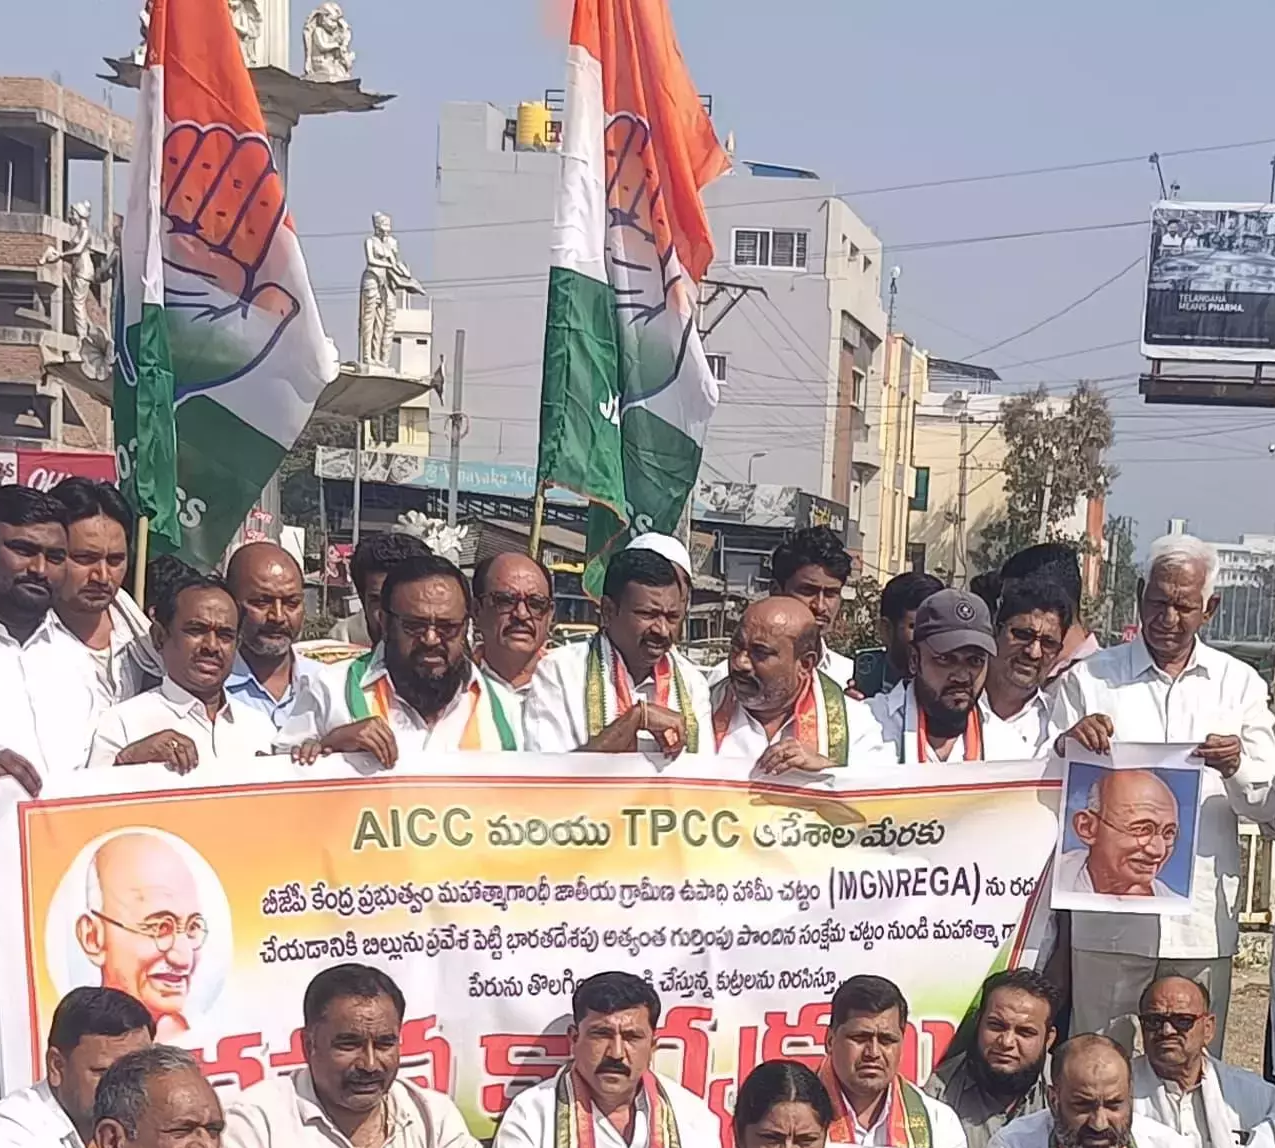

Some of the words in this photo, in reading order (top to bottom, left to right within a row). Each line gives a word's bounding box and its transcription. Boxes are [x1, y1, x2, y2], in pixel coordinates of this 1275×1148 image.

[439, 463, 509, 490] Vnayaka
[353, 807, 474, 850] AICC
[487, 814, 611, 847] మరియు
[622, 809, 740, 849] TPCC
[860, 817, 946, 848] మేరకు
[262, 883, 307, 915] బీజేపీ
[310, 882, 357, 916] కేంద్ర
[357, 883, 434, 914] ప్రభుత్వం
[555, 876, 615, 903] జాతీయ
[619, 877, 674, 909] గ్రామీణ
[679, 879, 729, 907] ఉపాధి
[732, 878, 774, 903] హామీ
[777, 880, 821, 911] చట్టం
[829, 862, 981, 909] (MGNREGA)
[985, 877, 1006, 896] ను
[259, 930, 359, 963] చేయడానికి
[362, 933, 425, 961] బిల్లును
[426, 924, 470, 957] ప్రవేశ
[473, 925, 503, 960] పెట్టి
[506, 922, 599, 954] భారతదేశపు
[603, 926, 667, 956] అత్యంత
[670, 924, 734, 955] గుర్తింపు
[849, 920, 884, 951] చట్టం
[887, 916, 930, 942] నుండి
[933, 919, 1000, 948] మహాత్మా
[468, 972, 524, 998] పేరును
[659, 967, 714, 999] చేస్తున్న
[716, 968, 776, 996] కుట్రలను
